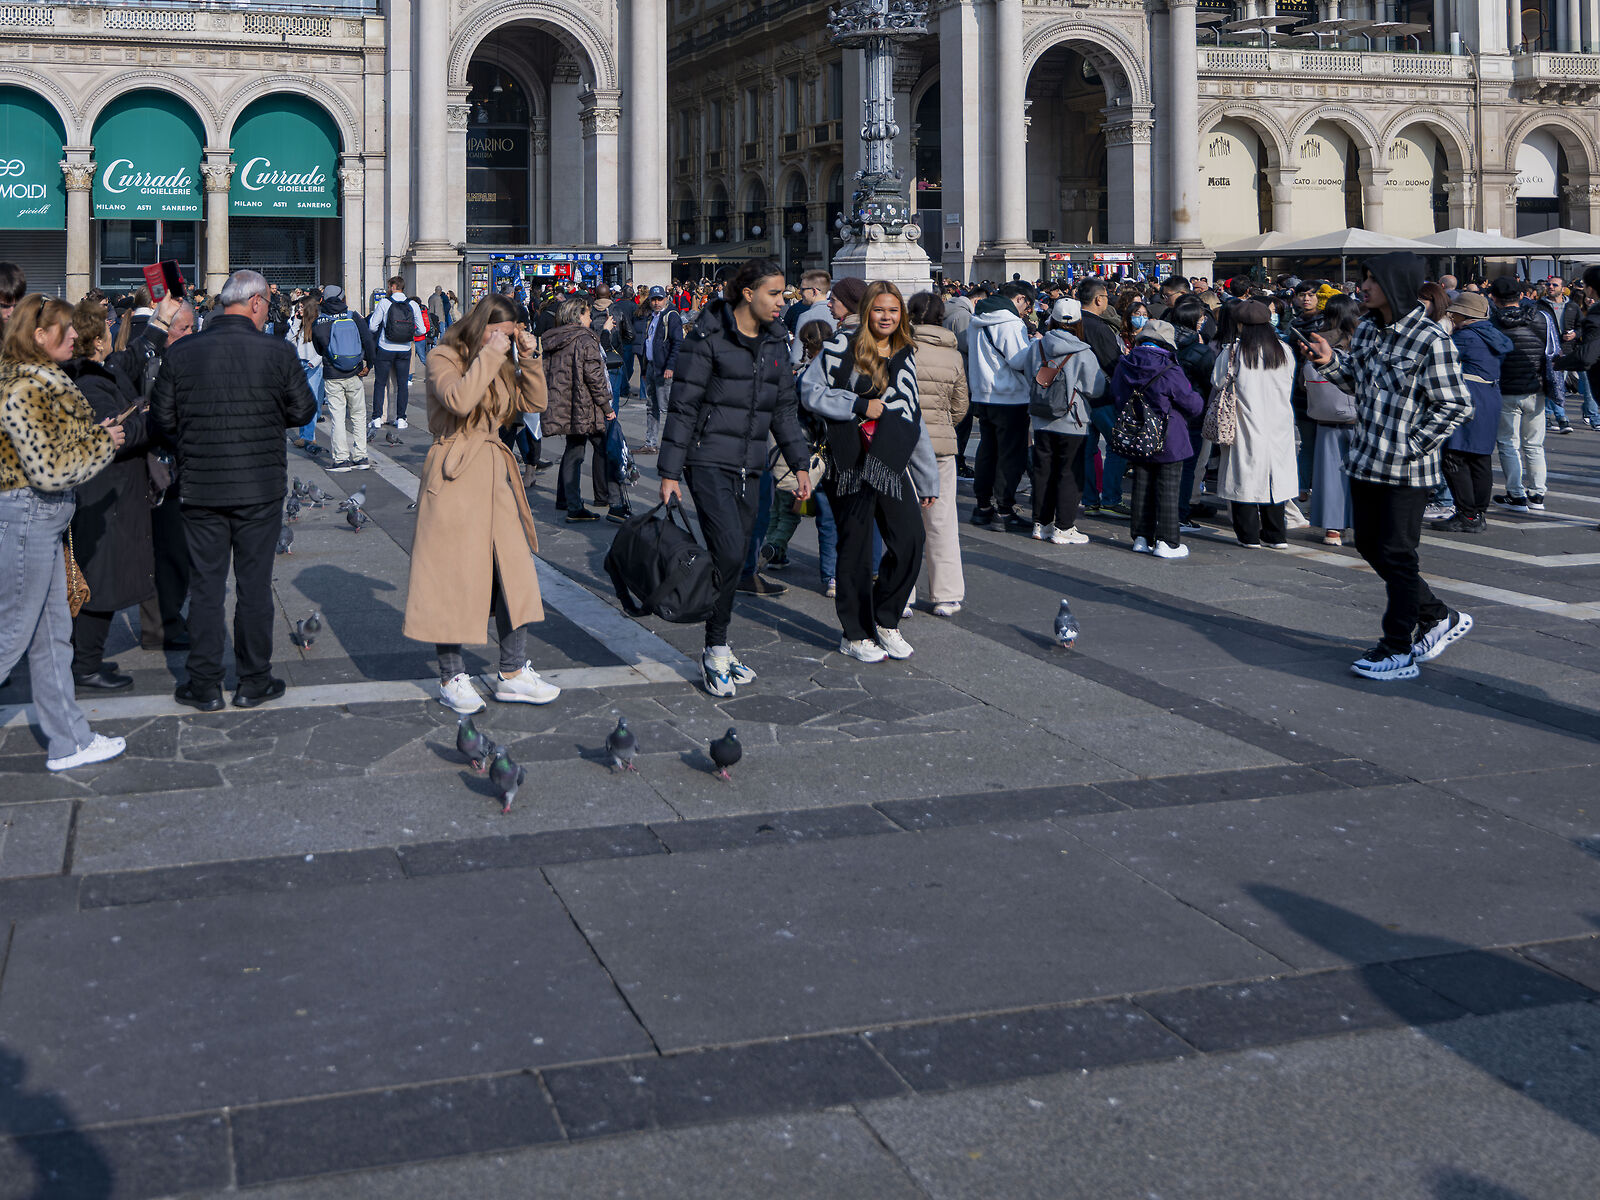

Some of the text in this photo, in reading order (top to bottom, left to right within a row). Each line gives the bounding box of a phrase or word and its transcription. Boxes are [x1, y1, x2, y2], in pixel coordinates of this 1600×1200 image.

[466, 137, 514, 152] PARINO
[102, 158, 192, 194] Currado
[240, 156, 327, 191] Currado
[1207, 177, 1231, 187] Motta
[0, 183, 47, 199] MOLDI
[140, 187, 191, 195] GIOIELLERIE
[276, 185, 325, 193] GIOIELLERIE
[96, 203, 126, 211] MILANO
[161, 204, 198, 212] SANREMO
[234, 200, 263, 208] MILANO
[16, 203, 52, 218] gioielli
